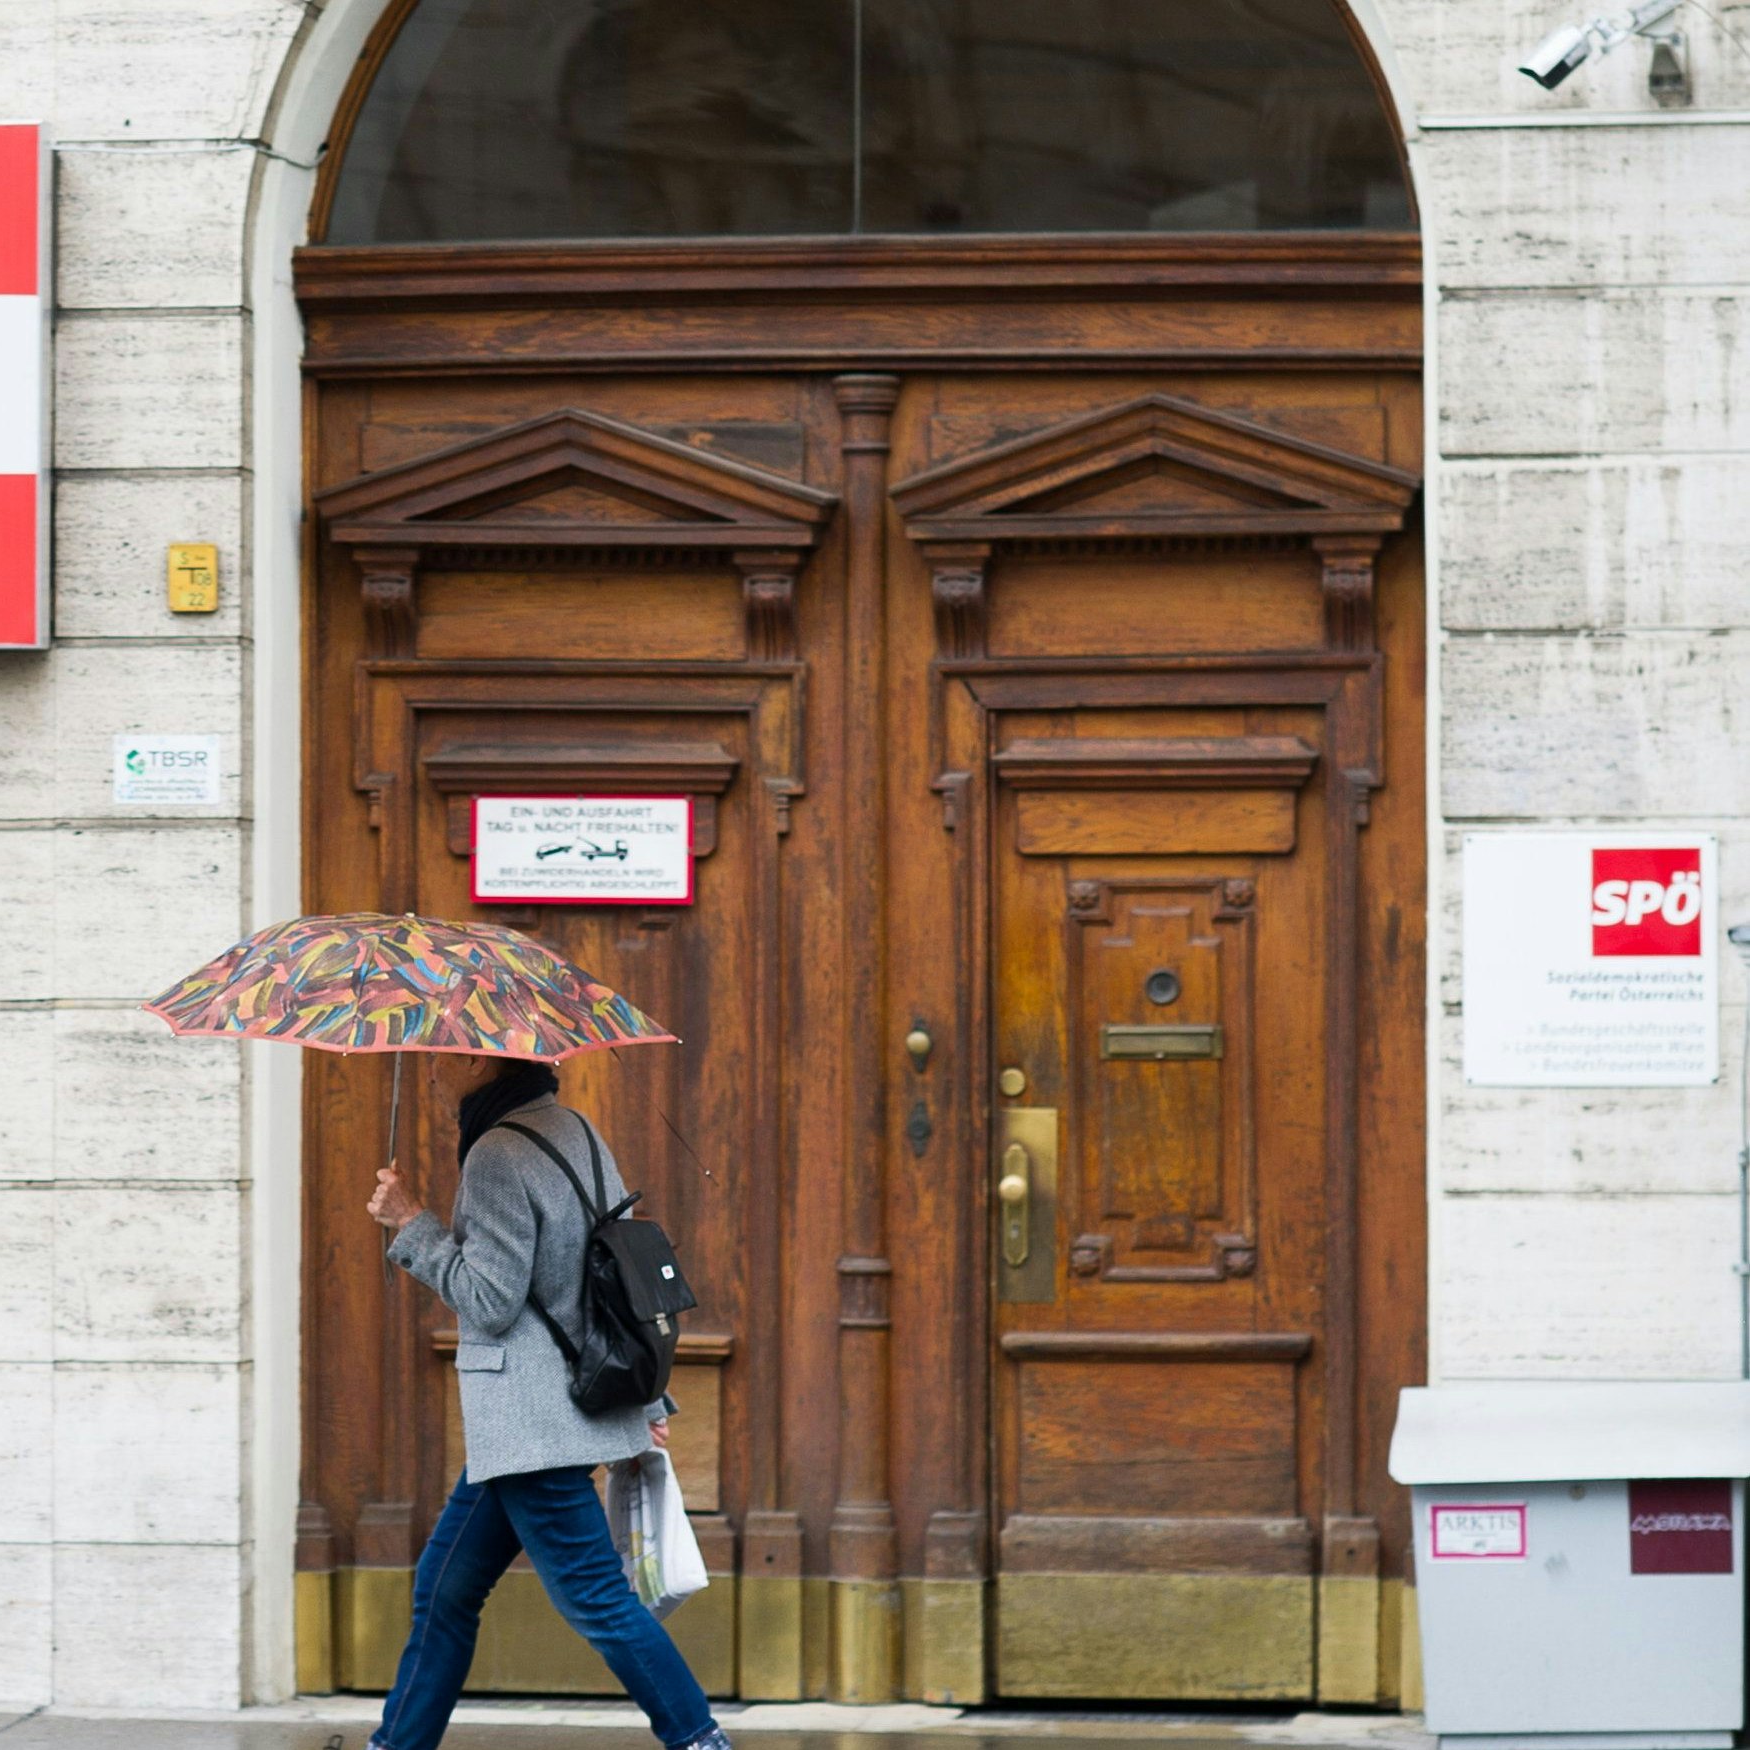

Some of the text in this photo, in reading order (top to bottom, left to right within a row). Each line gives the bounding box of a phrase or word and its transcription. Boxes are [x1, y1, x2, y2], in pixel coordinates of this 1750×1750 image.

[147, 750, 208, 767] TBSR
[542, 806, 573, 818] UND
[577, 806, 652, 818] AUSFAHRT
[487, 821, 513, 833] TAG
[534, 821, 581, 833] NACHT
[1592, 871, 1701, 926] SPÖ
[1546, 970, 1705, 984] Sozialdemokratische
[1569, 986, 1705, 1001] Partei Österreichs
[1440, 1515, 1518, 1531] ARKTIS
